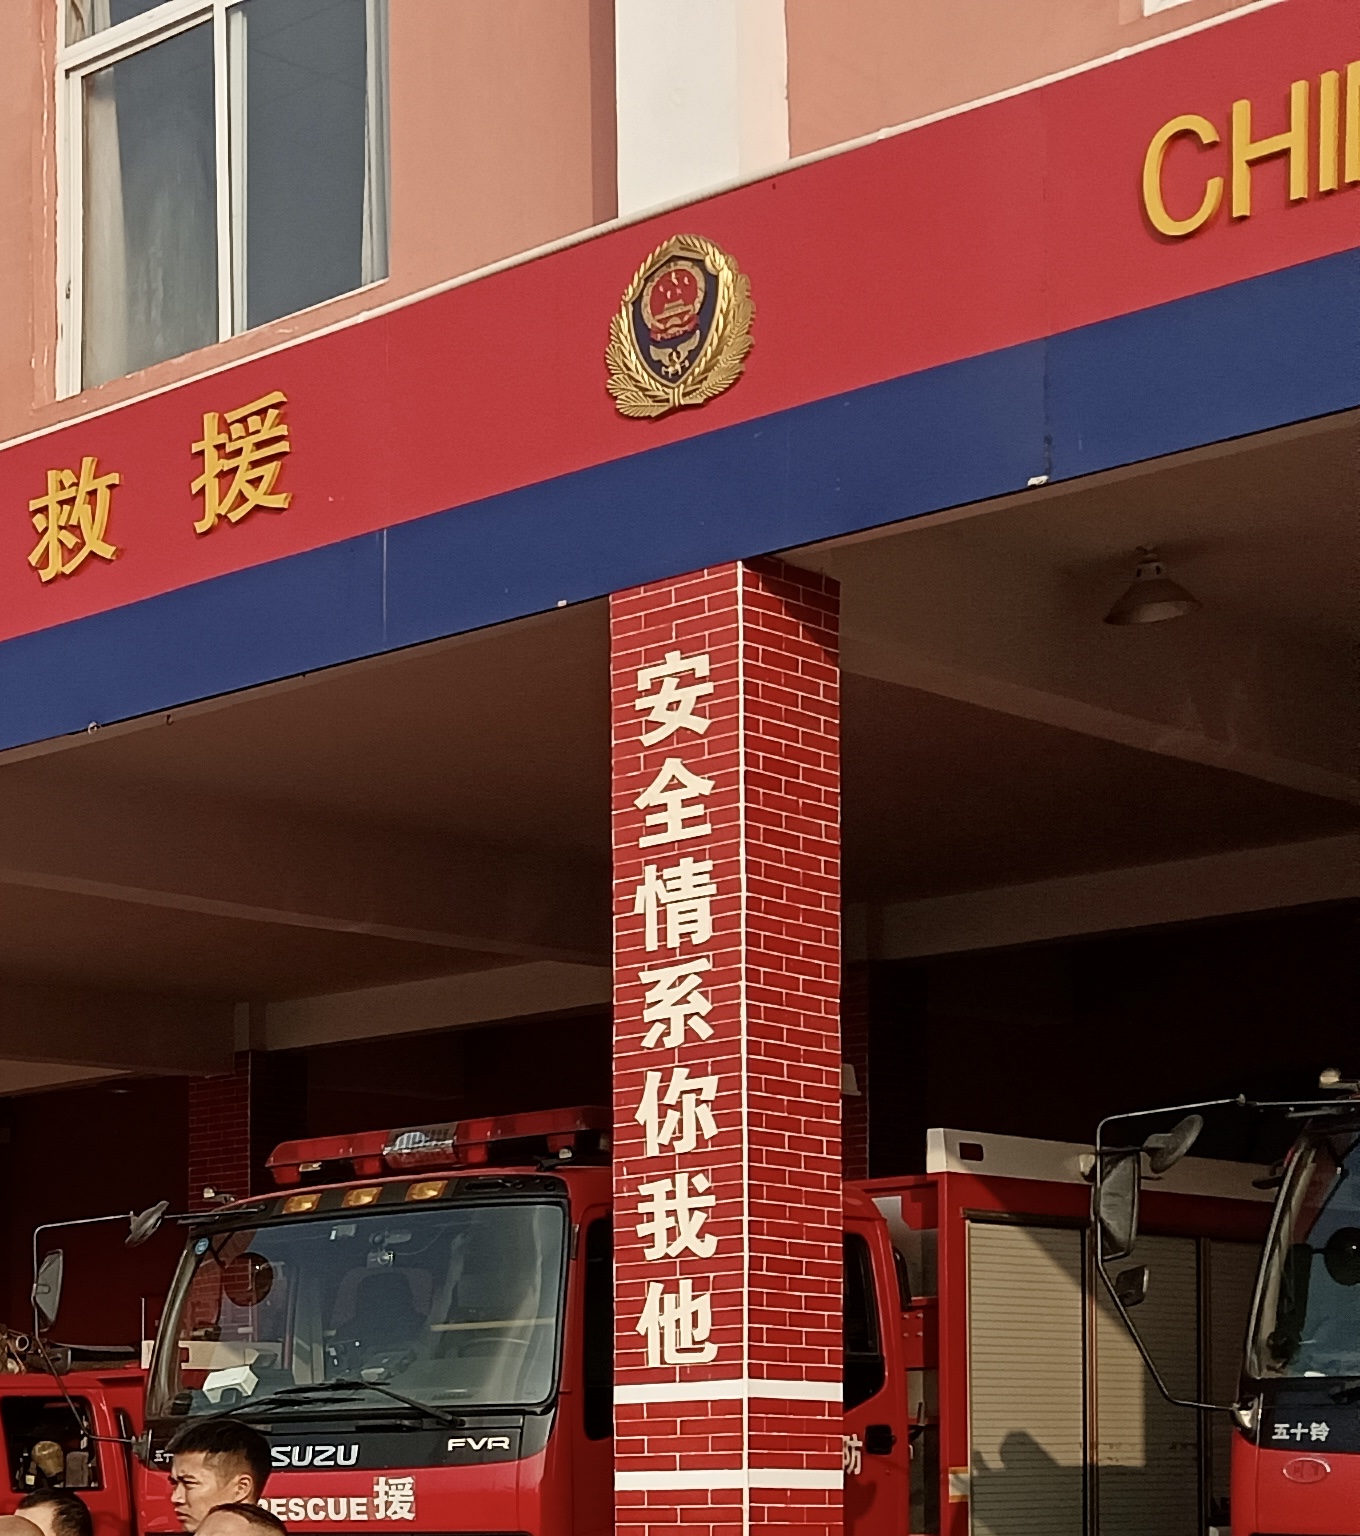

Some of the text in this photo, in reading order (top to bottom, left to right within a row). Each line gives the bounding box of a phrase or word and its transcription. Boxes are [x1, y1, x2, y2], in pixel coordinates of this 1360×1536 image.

[1142, 60, 1360, 237] CHI
[634, 649, 720, 1369] 安全情系你我他
[446, 1436, 511, 1452] FVR
[1271, 1421, 1330, 1442] 五十铃
[270, 1443, 360, 1468] SUZU
[373, 1475, 416, 1521] 援
